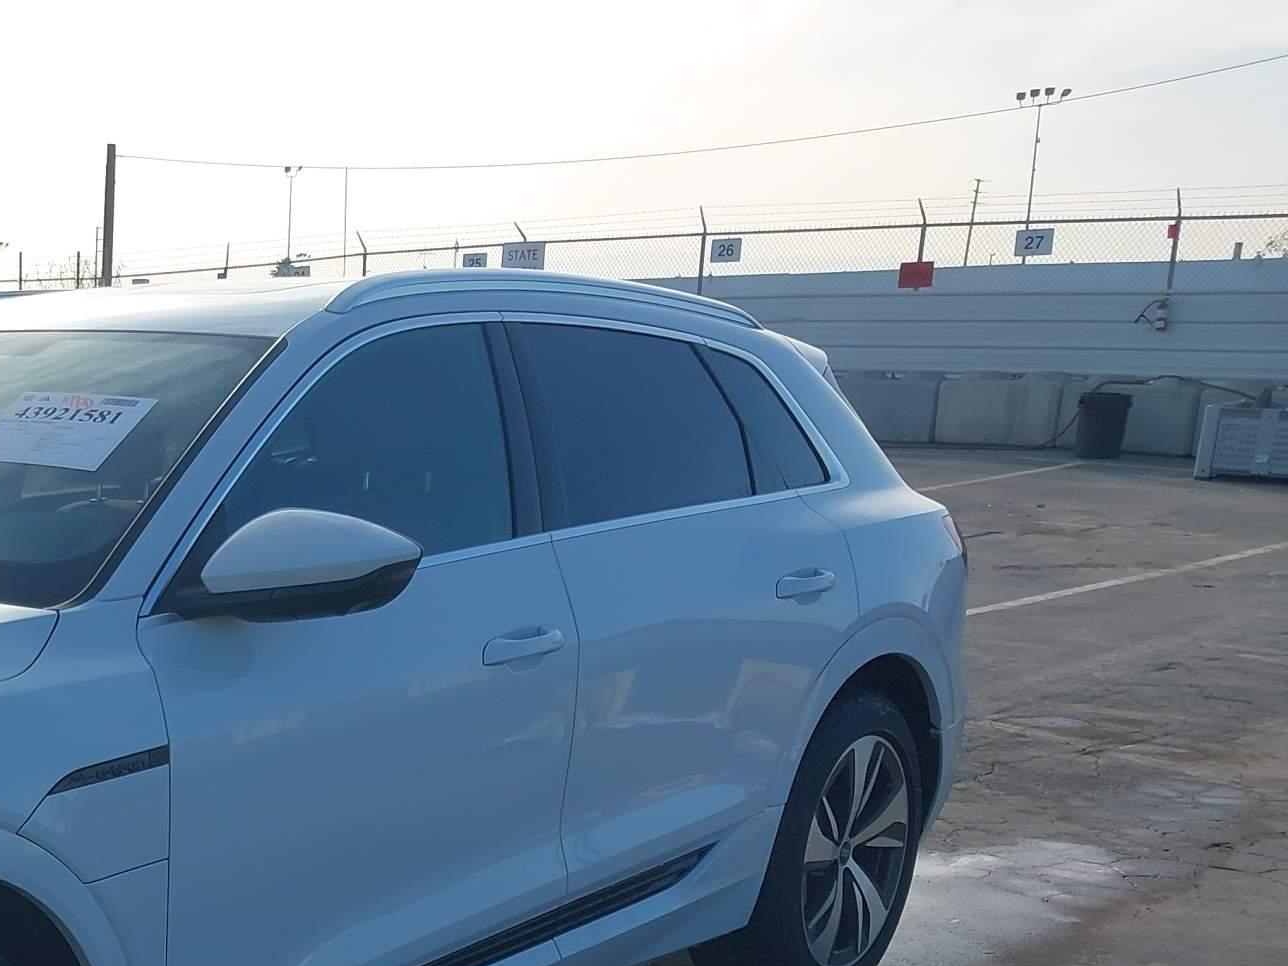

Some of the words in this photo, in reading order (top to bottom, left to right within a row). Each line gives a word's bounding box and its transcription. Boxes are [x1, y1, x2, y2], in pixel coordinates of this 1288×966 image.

[1024, 236, 1045, 250] 27
[508, 249, 539, 261] STATE
[718, 244, 735, 257] 26
[14, 406, 123, 424] 43921581
